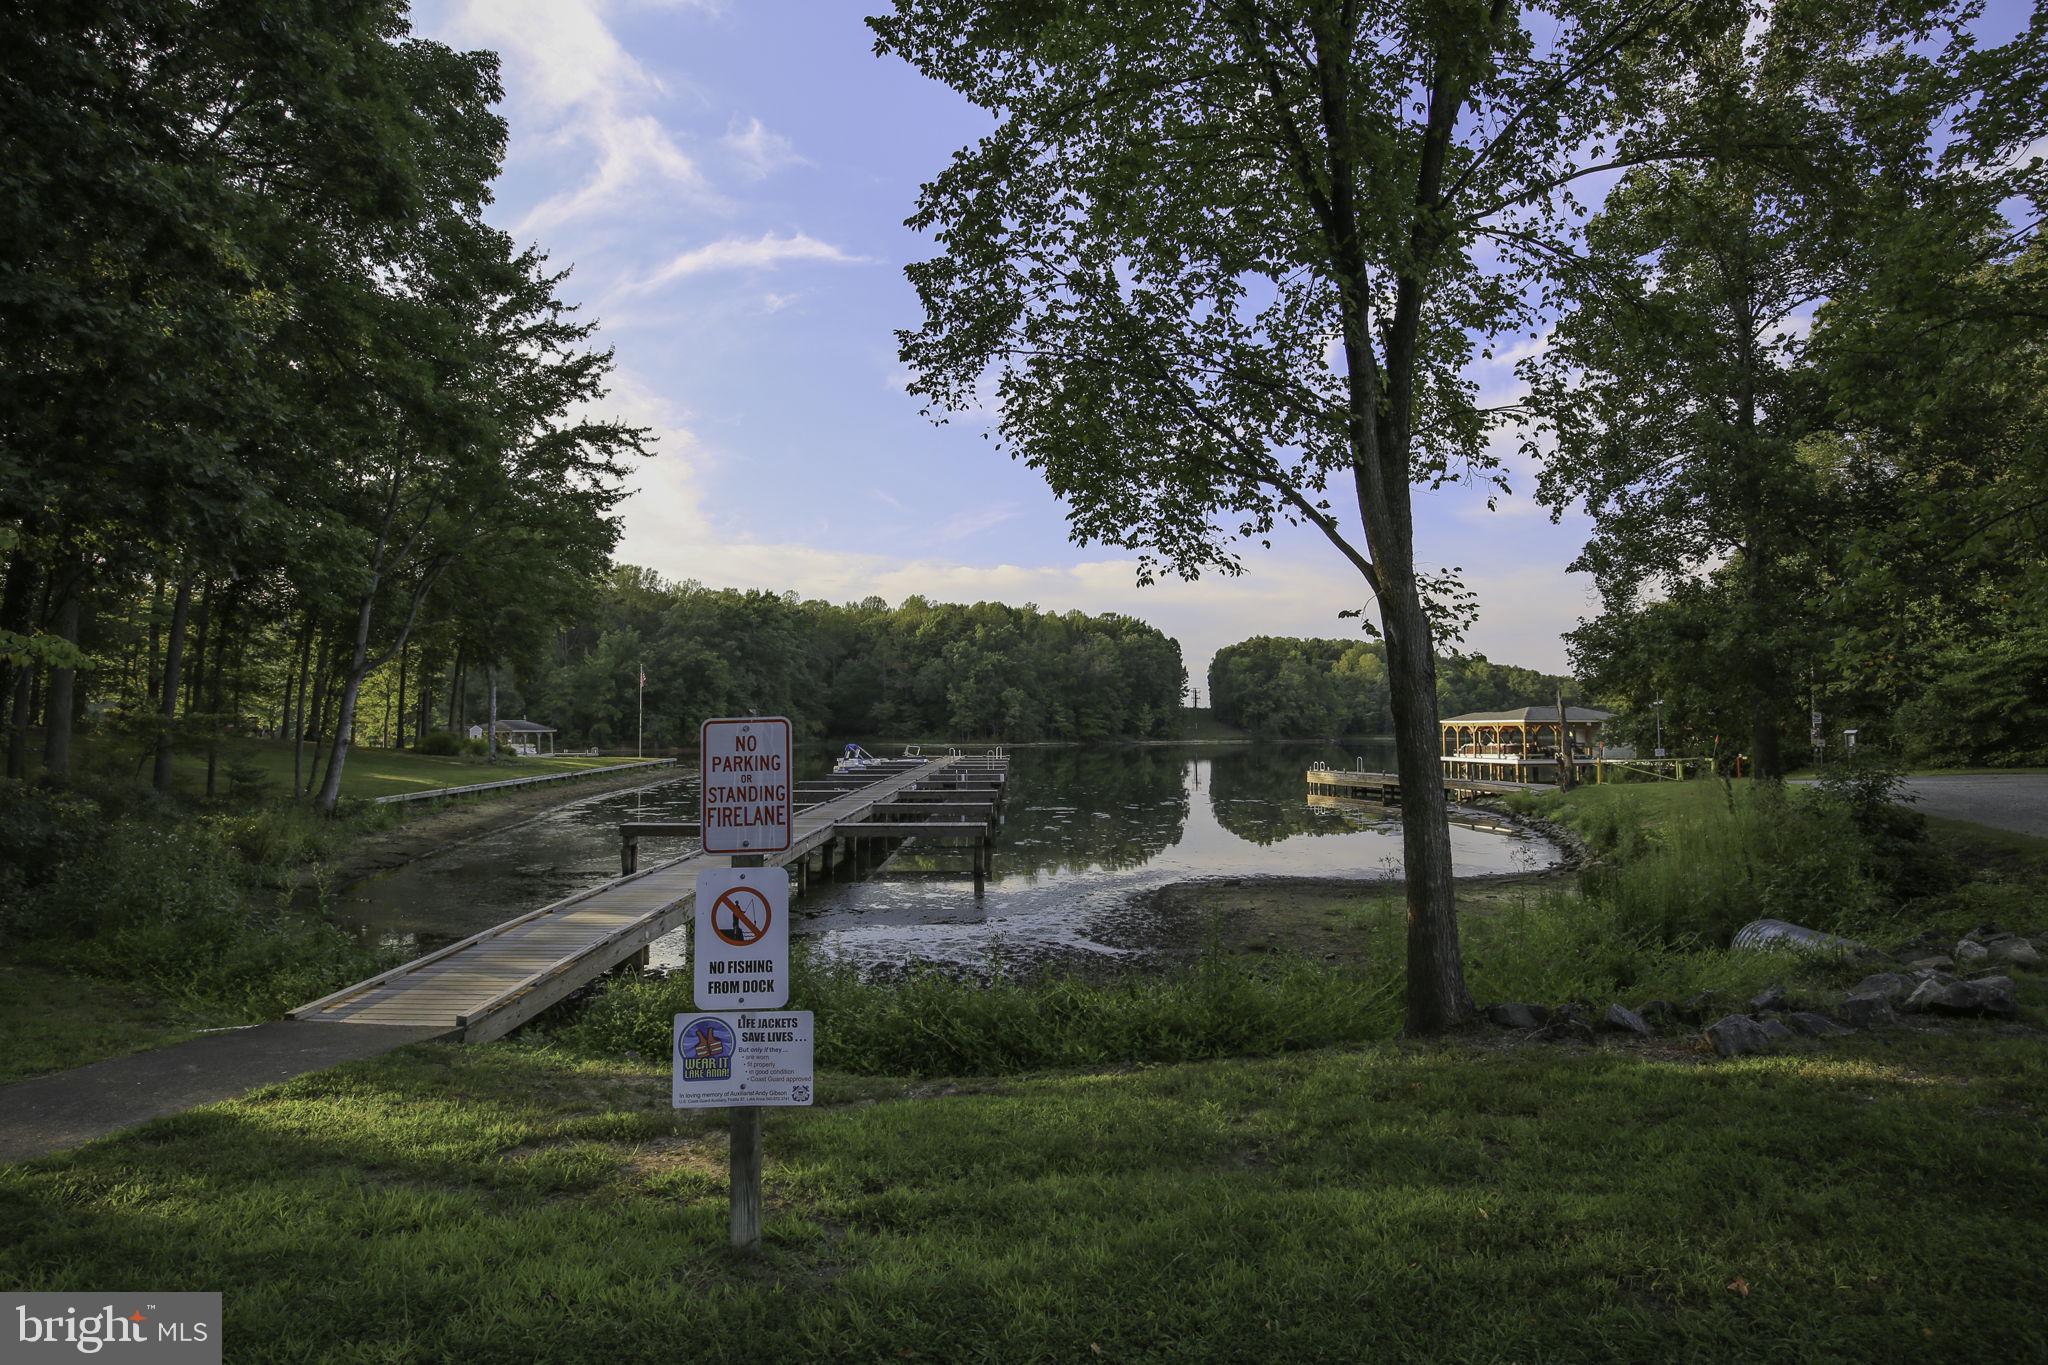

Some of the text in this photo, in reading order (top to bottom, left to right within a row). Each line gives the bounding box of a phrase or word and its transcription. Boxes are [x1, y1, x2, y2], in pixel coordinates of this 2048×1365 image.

[736, 735, 757, 752] NO
[712, 755, 781, 772] PARKING
[741, 775, 752, 783] OR
[708, 785, 786, 803] STANDING
[707, 805, 786, 827] FIRELANE
[709, 960, 773, 974] NO FISHING
[708, 980, 775, 994] FROM DOCK
[738, 1018, 798, 1028] LIFE JACKETS
[742, 1032, 765, 1042] SAVE
[685, 1057, 729, 1070] WEAR IT
[685, 1069, 729, 1078] LAKE ANNA!
